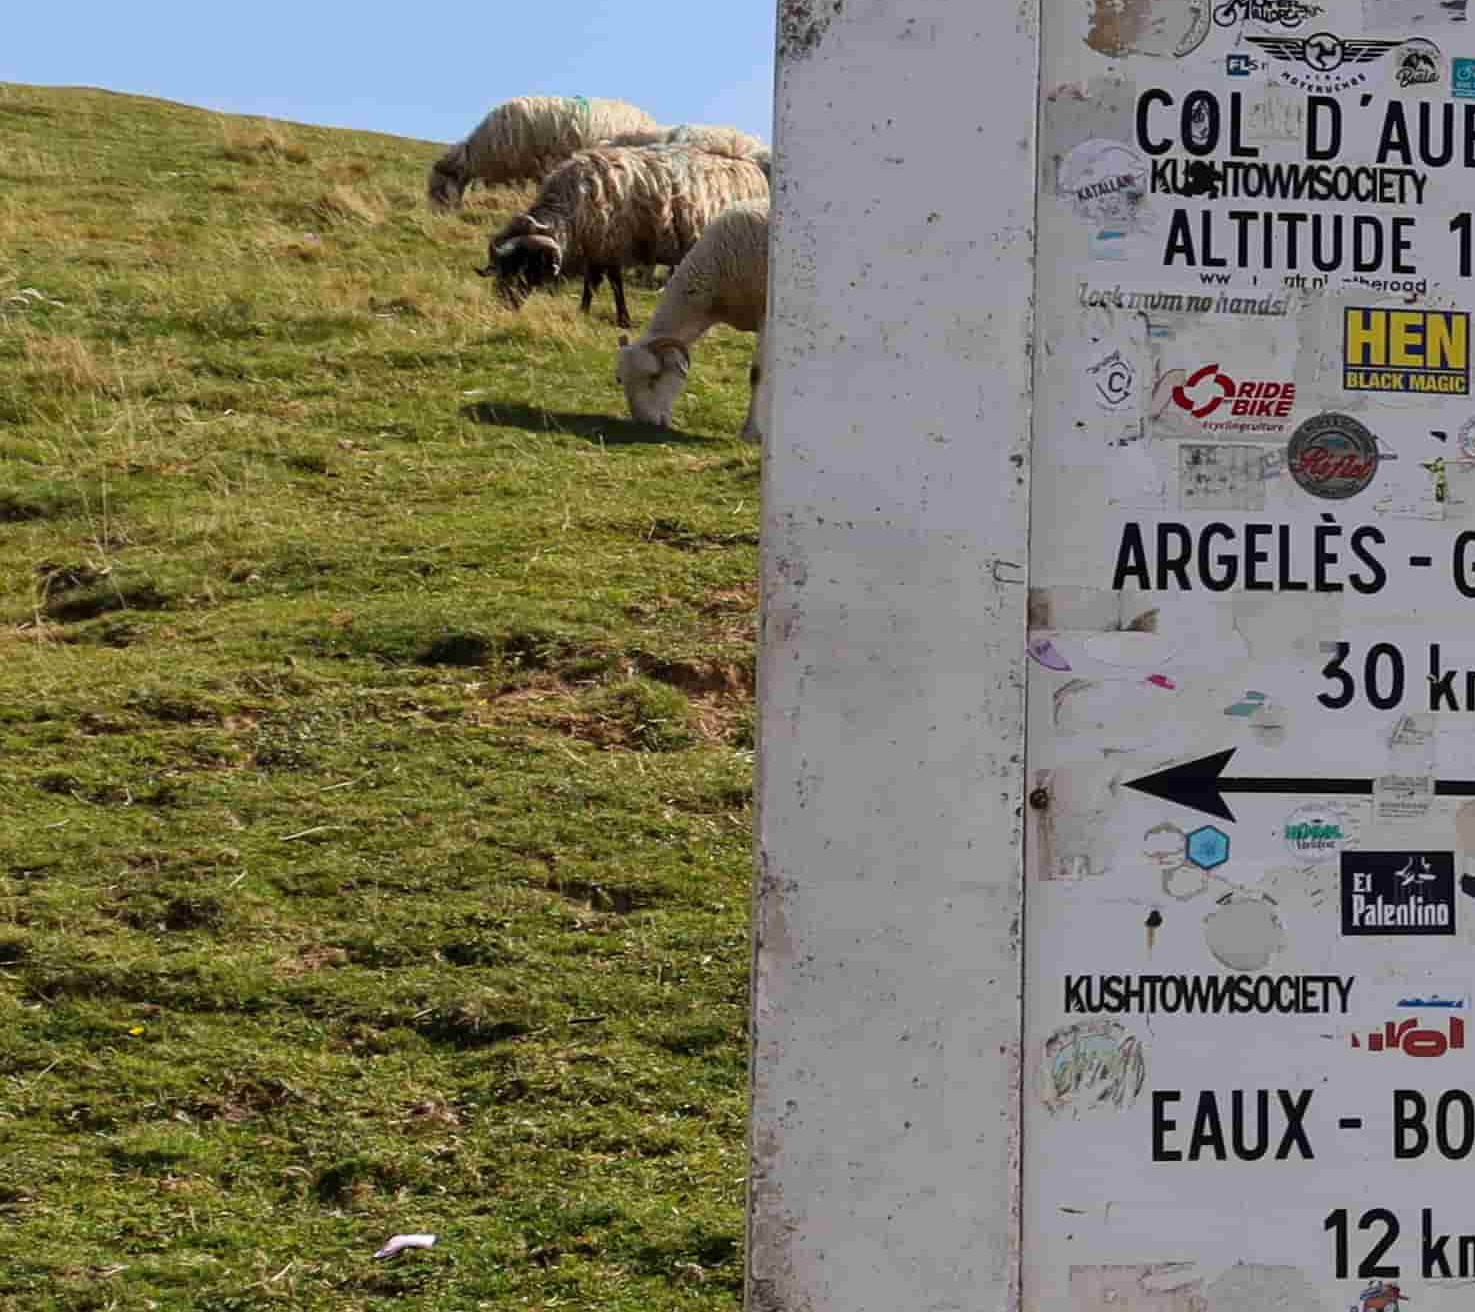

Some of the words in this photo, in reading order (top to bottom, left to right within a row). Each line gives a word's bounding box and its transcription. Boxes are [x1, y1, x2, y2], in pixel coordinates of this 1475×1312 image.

[1136, 88, 1259, 158] COL
[1163, 208, 1417, 274] ALTITUDE
[1186, 294, 1213, 313] no
[1346, 308, 1466, 370] HEN
[1231, 399, 1295, 418] BIKE
[1235, 381, 1296, 400] RIDE
[1347, 371, 1404, 391] BLACK
[1409, 372, 1467, 393] MAGIC
[1112, 512, 1388, 595] ARGELÈS
[1317, 641, 1406, 711] 30
[1351, 893, 1450, 927] Palentino
[1151, 1089, 1315, 1163] EAUX
[1323, 1207, 1401, 1280] 12
